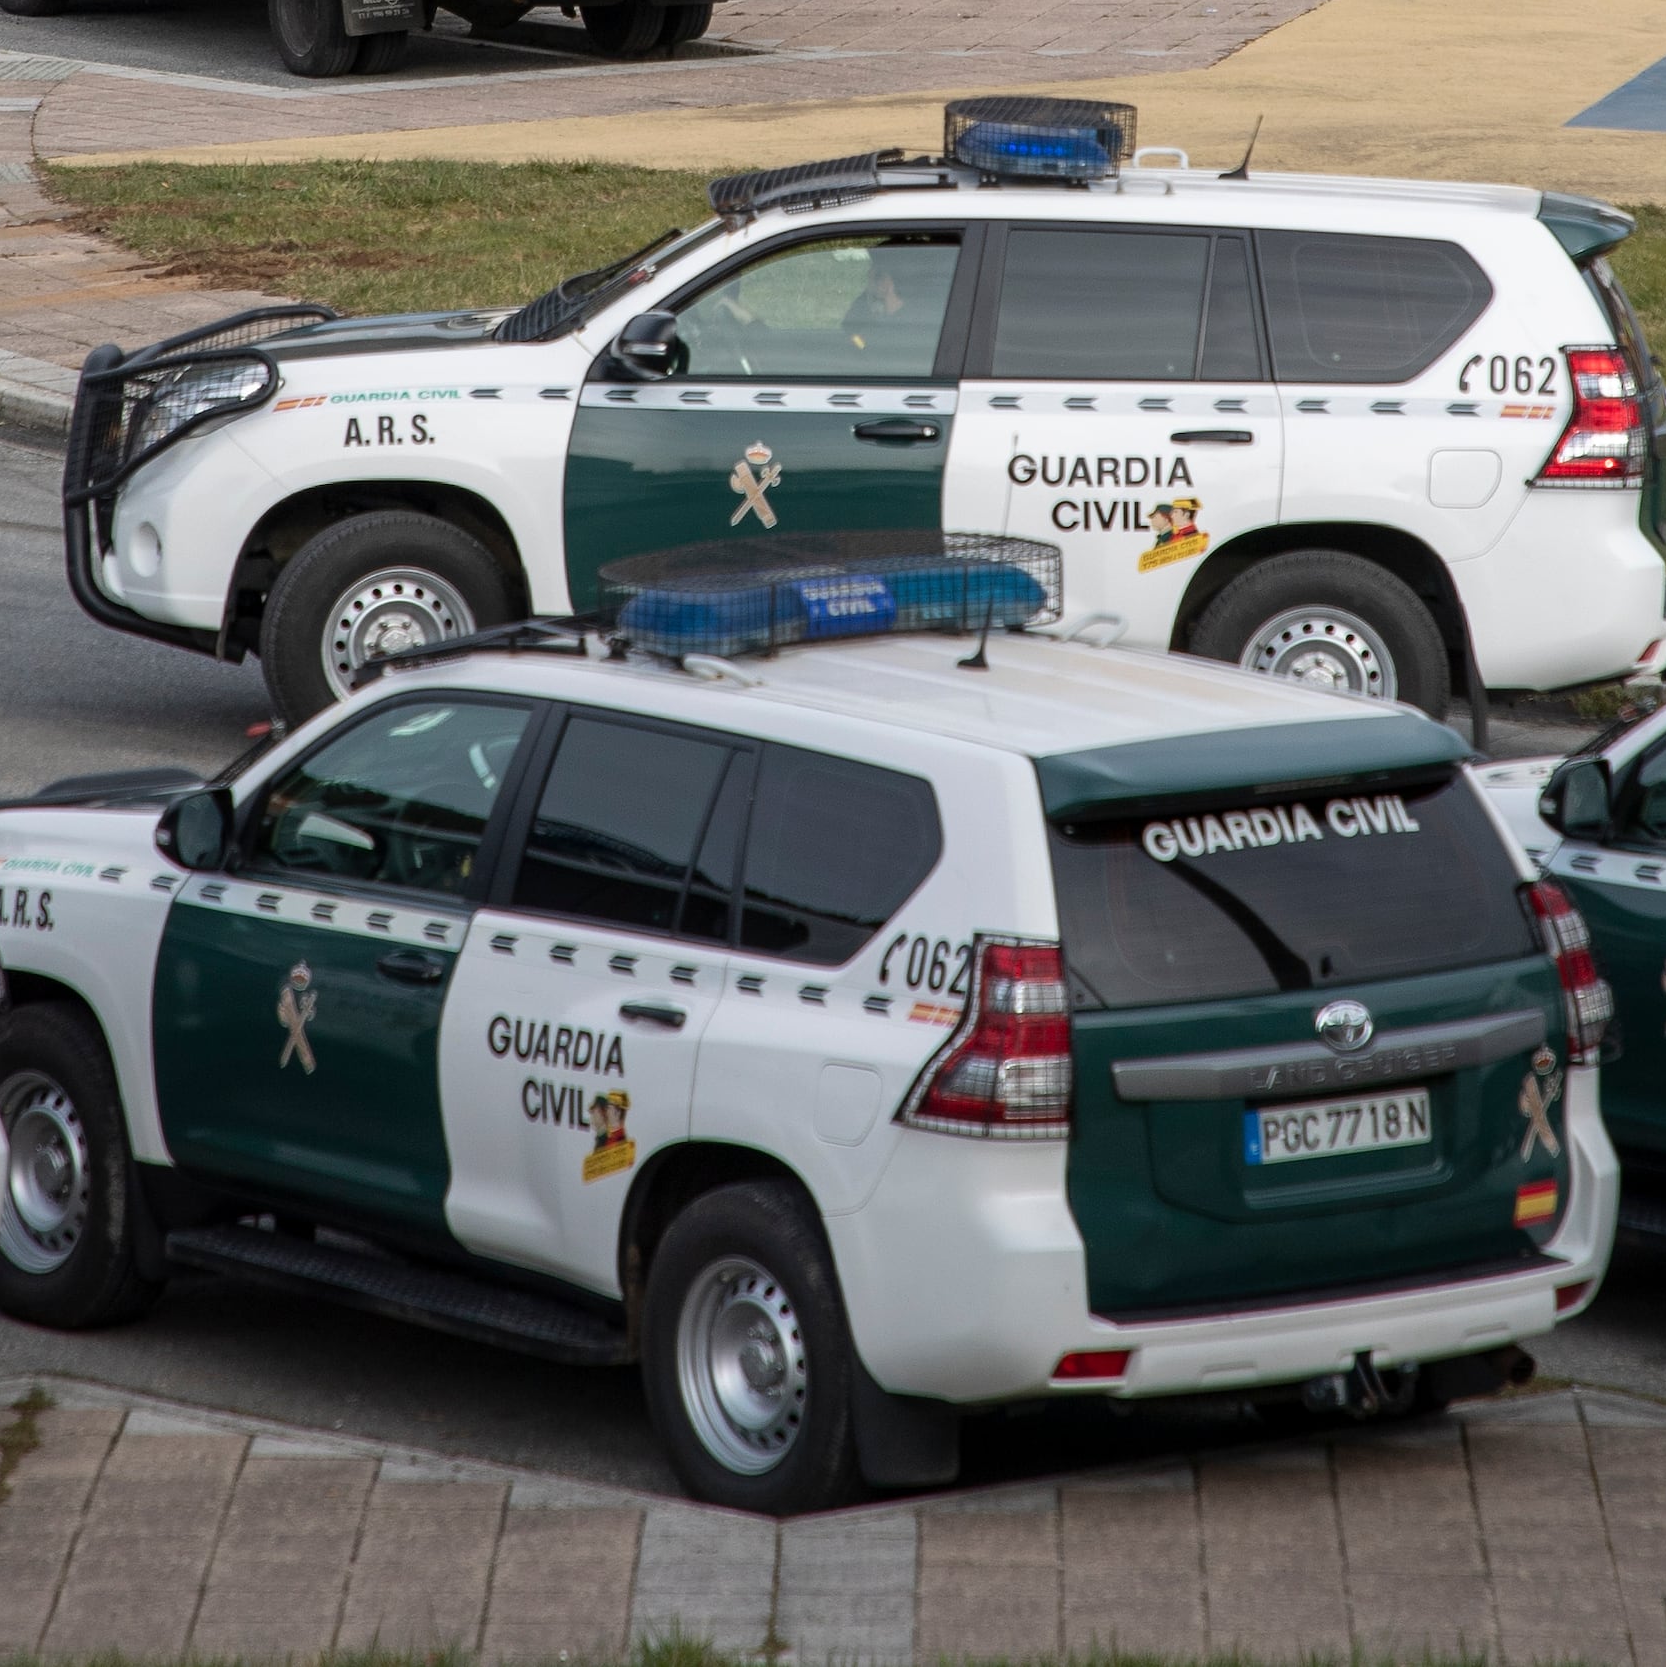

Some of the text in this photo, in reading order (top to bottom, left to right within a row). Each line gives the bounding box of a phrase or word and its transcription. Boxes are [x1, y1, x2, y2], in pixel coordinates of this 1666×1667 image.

[331, 389, 461, 404] GUARDIA CIVIL
[1488, 356, 1557, 394] 062
[1008, 454, 1193, 488] GUARDIA
[1051, 500, 1150, 532] CIVIL
[1144, 794, 1420, 862] GUARDIA CIVIL
[906, 936, 972, 996] 062
[488, 1015, 625, 1078] GUARDIA
[1248, 1045, 1458, 1091] LAND CRUISER
[521, 1079, 591, 1132] CIVIL
